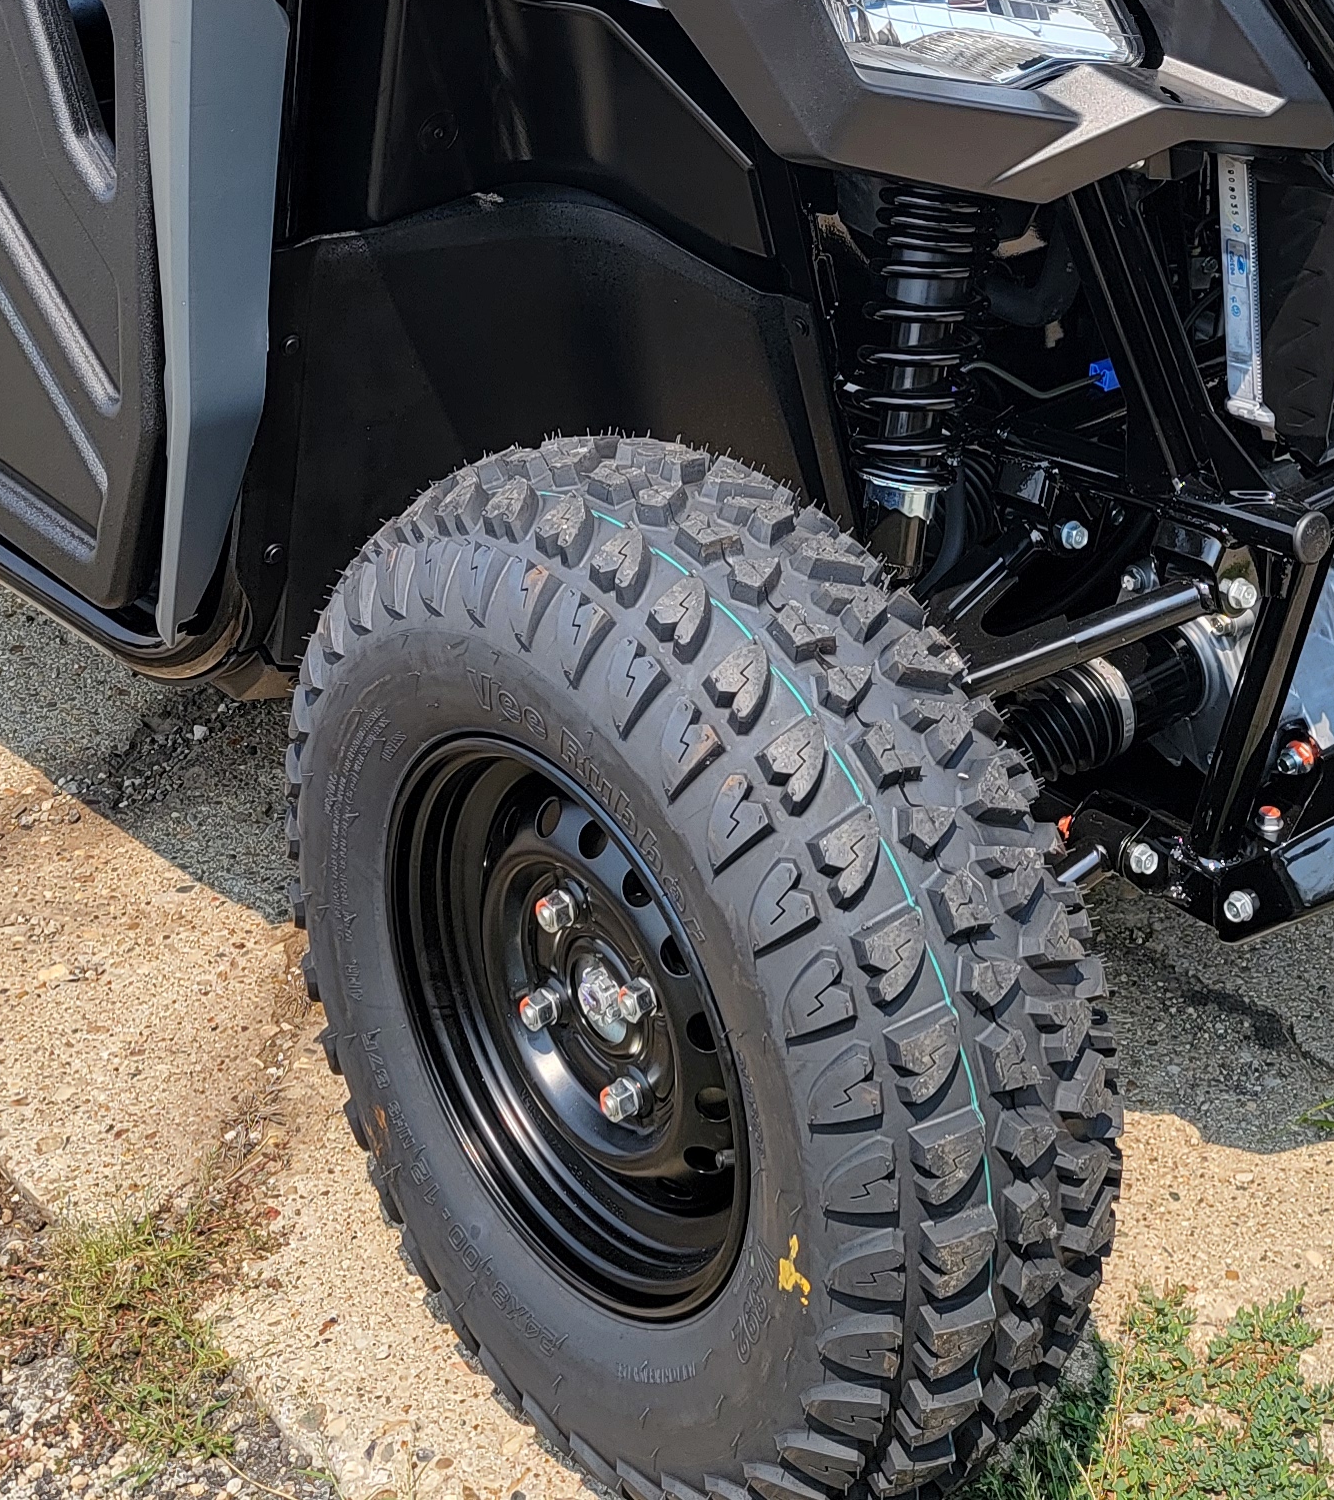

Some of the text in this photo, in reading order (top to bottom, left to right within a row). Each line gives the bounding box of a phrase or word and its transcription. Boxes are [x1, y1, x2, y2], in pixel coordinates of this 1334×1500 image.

[465, 668, 707, 946] Vee Rubber
[385, 1099, 418, 1149] NHS
